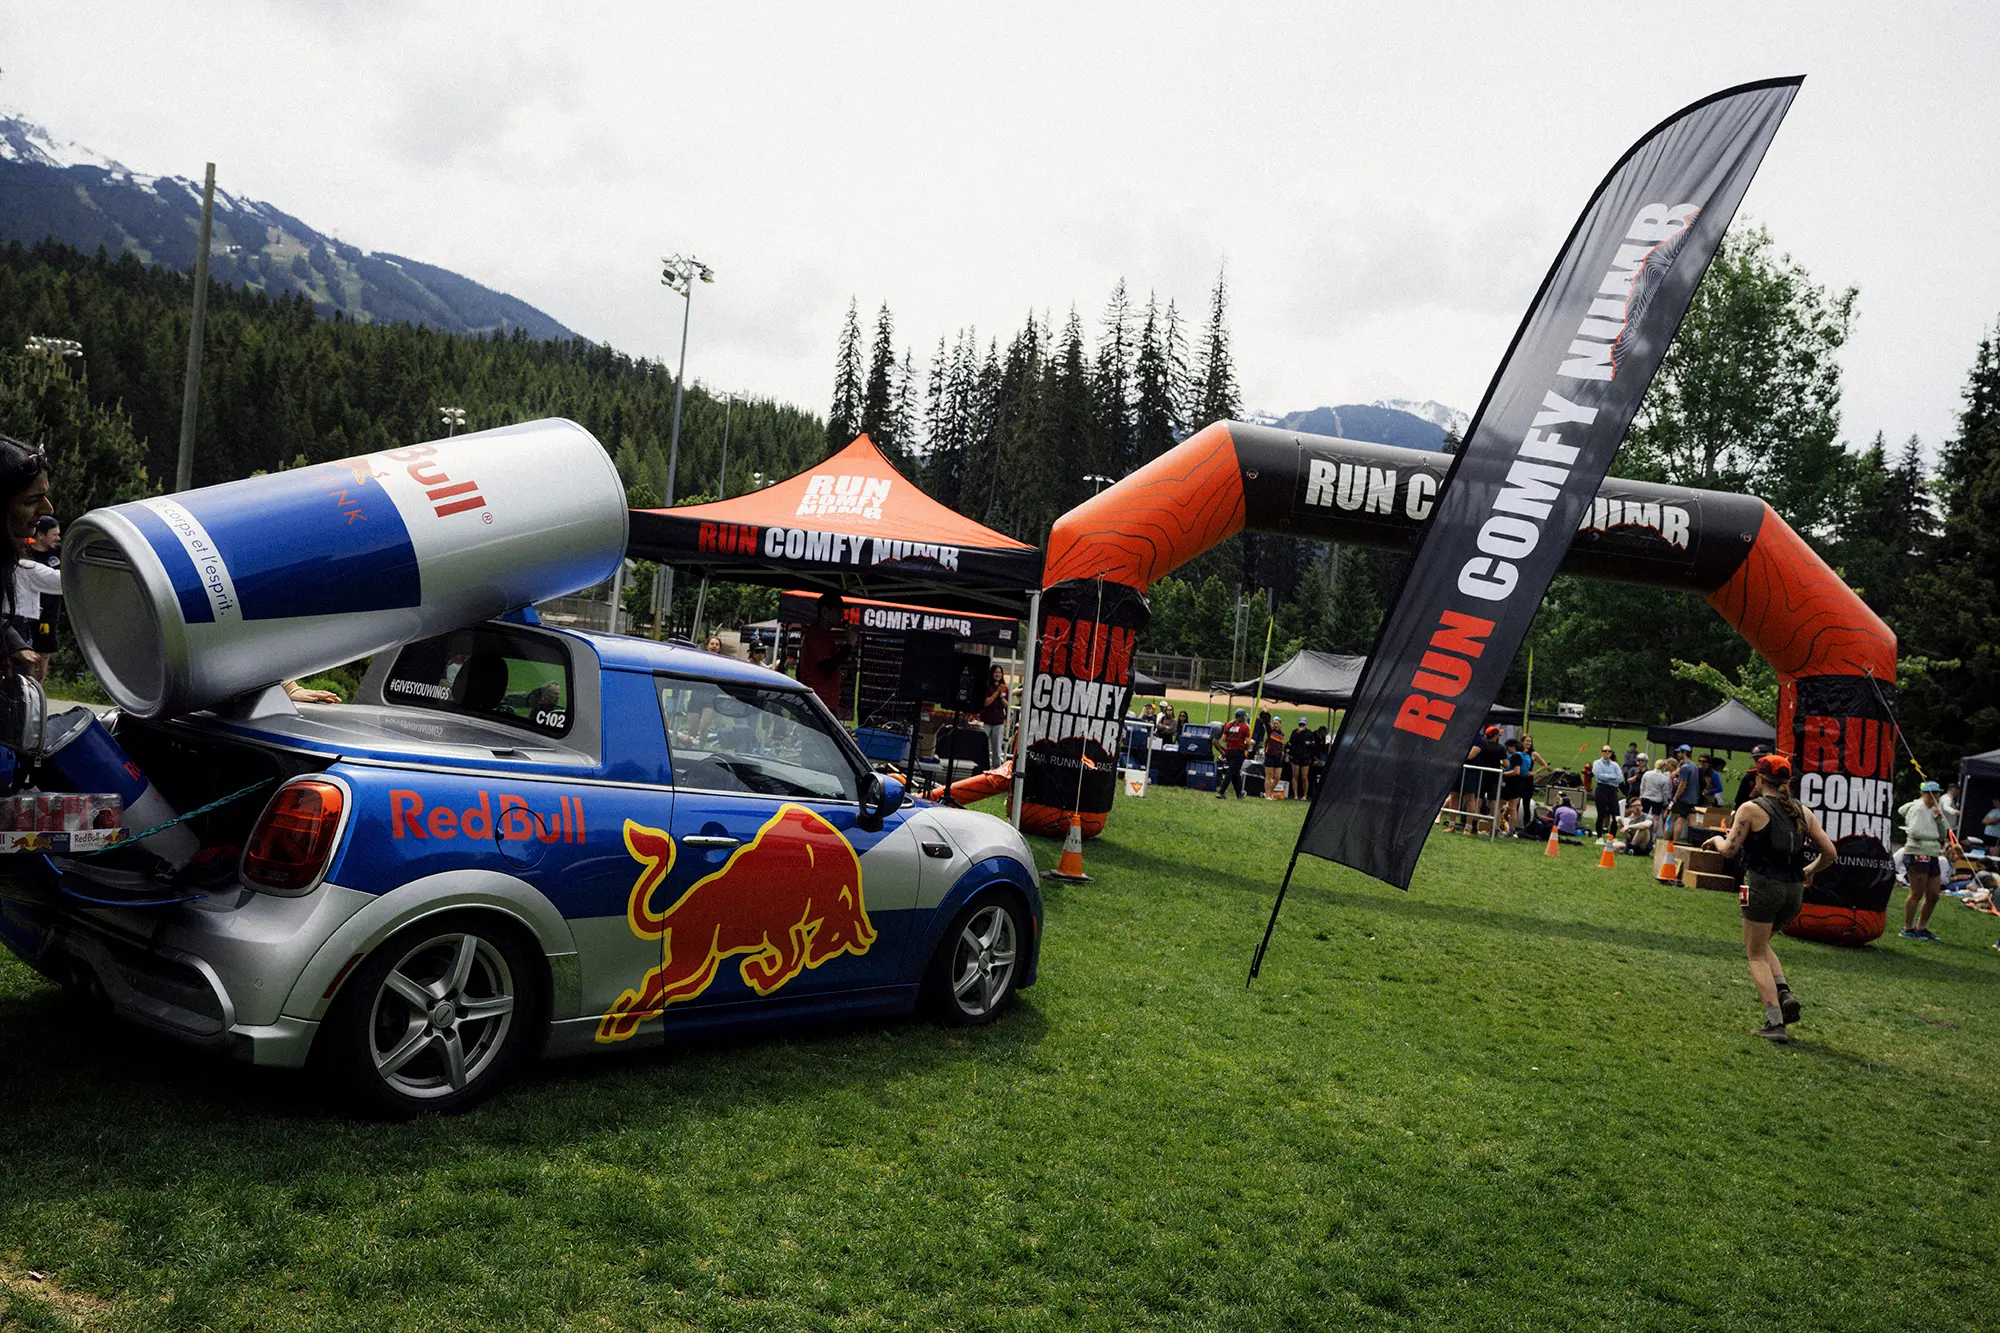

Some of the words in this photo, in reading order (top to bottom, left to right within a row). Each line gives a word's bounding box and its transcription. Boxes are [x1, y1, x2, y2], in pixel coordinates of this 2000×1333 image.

[801, 494, 888, 509] COMFY
[804, 474, 892, 498] RUN
[1305, 458, 1397, 514] RUN
[164, 508, 195, 536] corps
[192, 540, 208, 552] et
[698, 522, 759, 556] RUN
[764, 527, 867, 564] COMFY
[1393, 609, 1496, 741] RUN
[1458, 389, 1600, 601] COMFY
[864, 608, 920, 631] COMFY
[1039, 615, 1136, 685] RUN
[389, 678, 451, 700] #GIVESYOUWINGS
[1032, 673, 1128, 720] COMFY
[536, 710, 566, 728] C102
[1050, 754, 1094, 770] RUNNI
